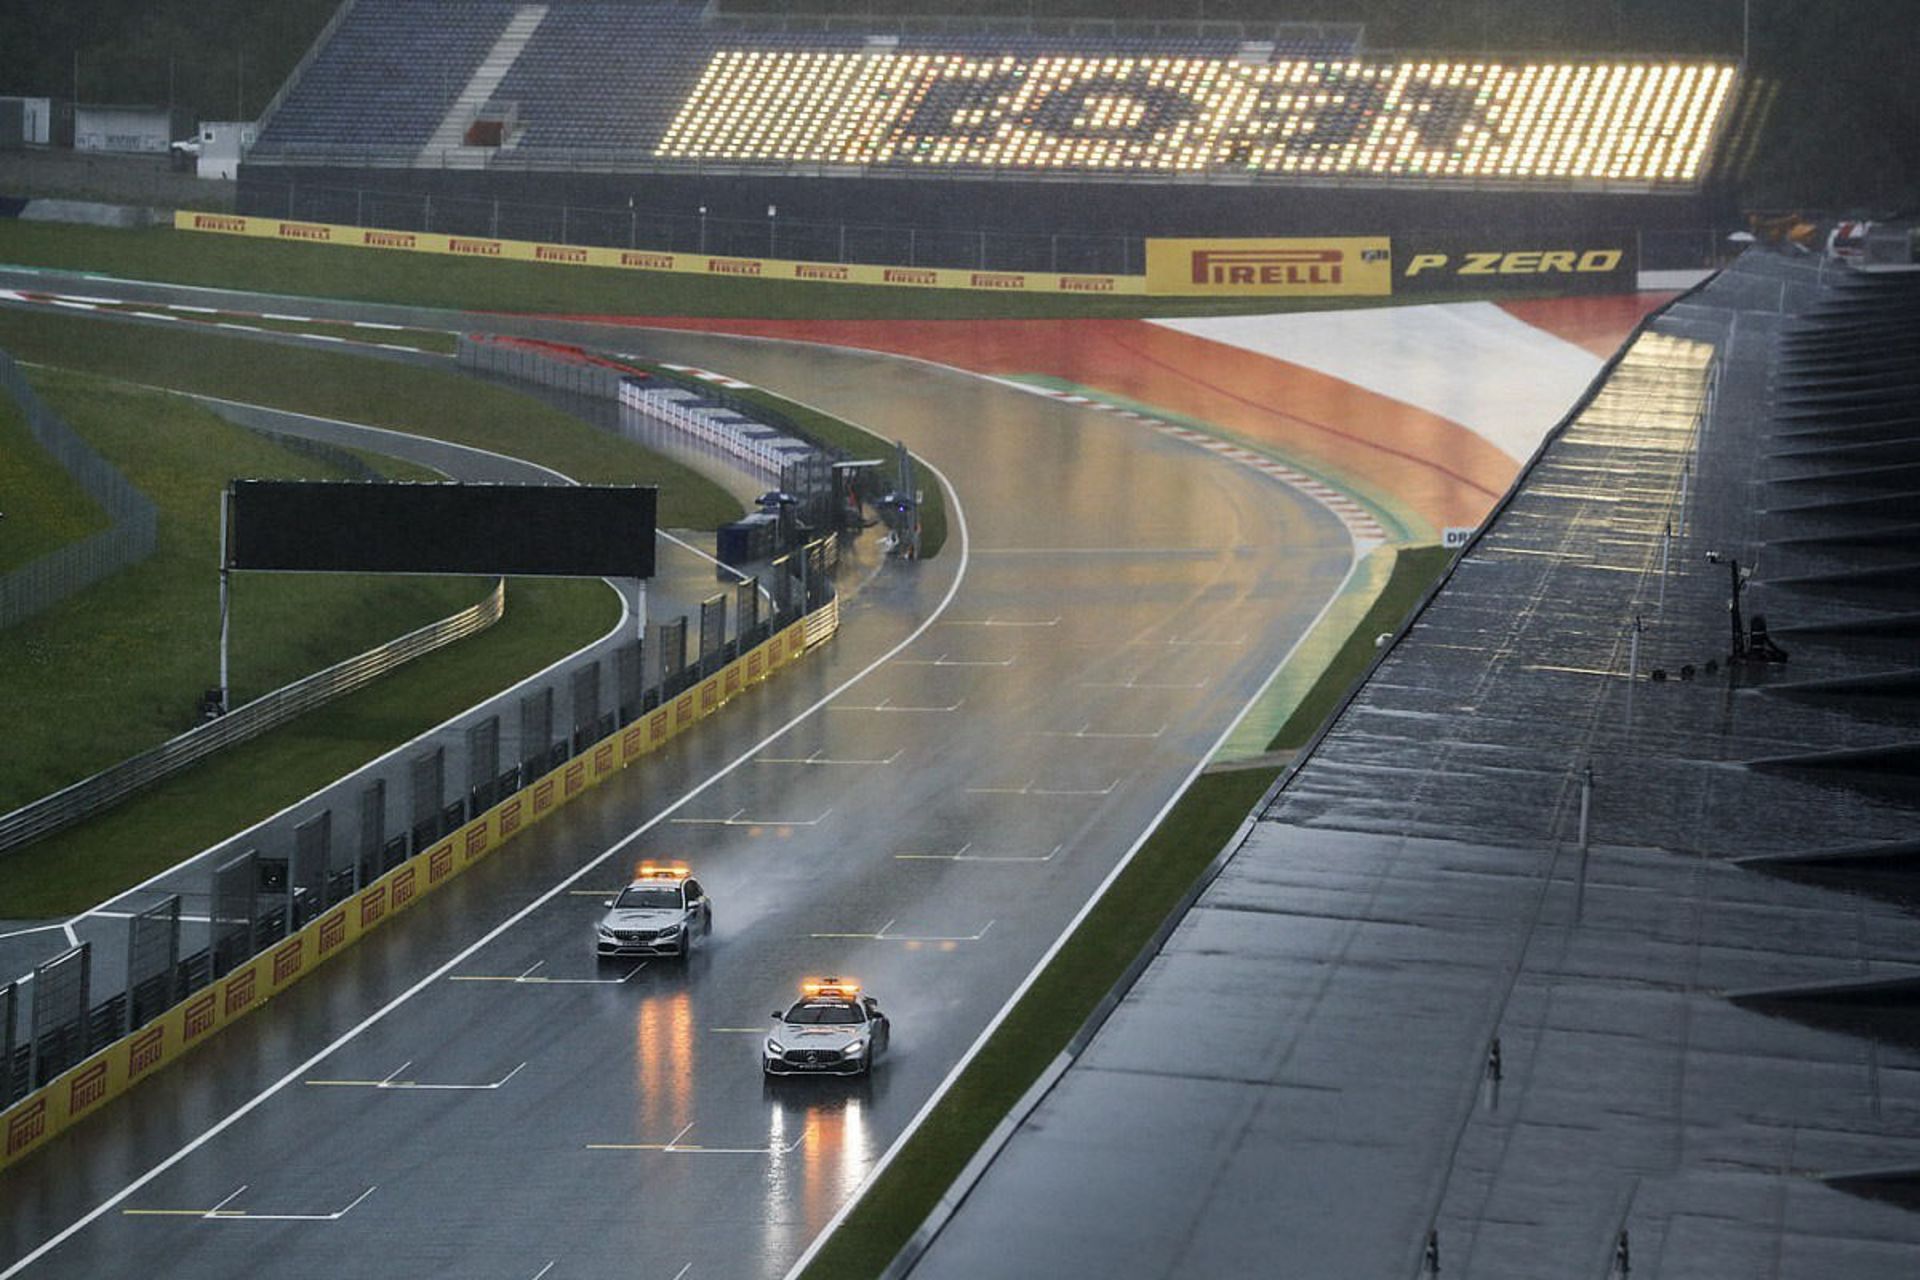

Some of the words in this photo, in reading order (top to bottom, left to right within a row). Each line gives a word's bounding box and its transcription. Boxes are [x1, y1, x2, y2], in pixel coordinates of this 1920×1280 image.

[1192, 250, 1343, 284] PIRELLI
[1405, 254, 1449, 276] P
[1458, 250, 1623, 273] ZERO
[319, 911, 346, 954] PIRELLI
[274, 939, 302, 985] PIRELLI
[225, 968, 256, 1016] PIRELLI
[184, 994, 216, 1041] PIRELLI
[129, 1026, 164, 1078] PIRELLI
[70, 1060, 107, 1115] PIRELLI
[8, 1098, 46, 1156] PIRELLI
